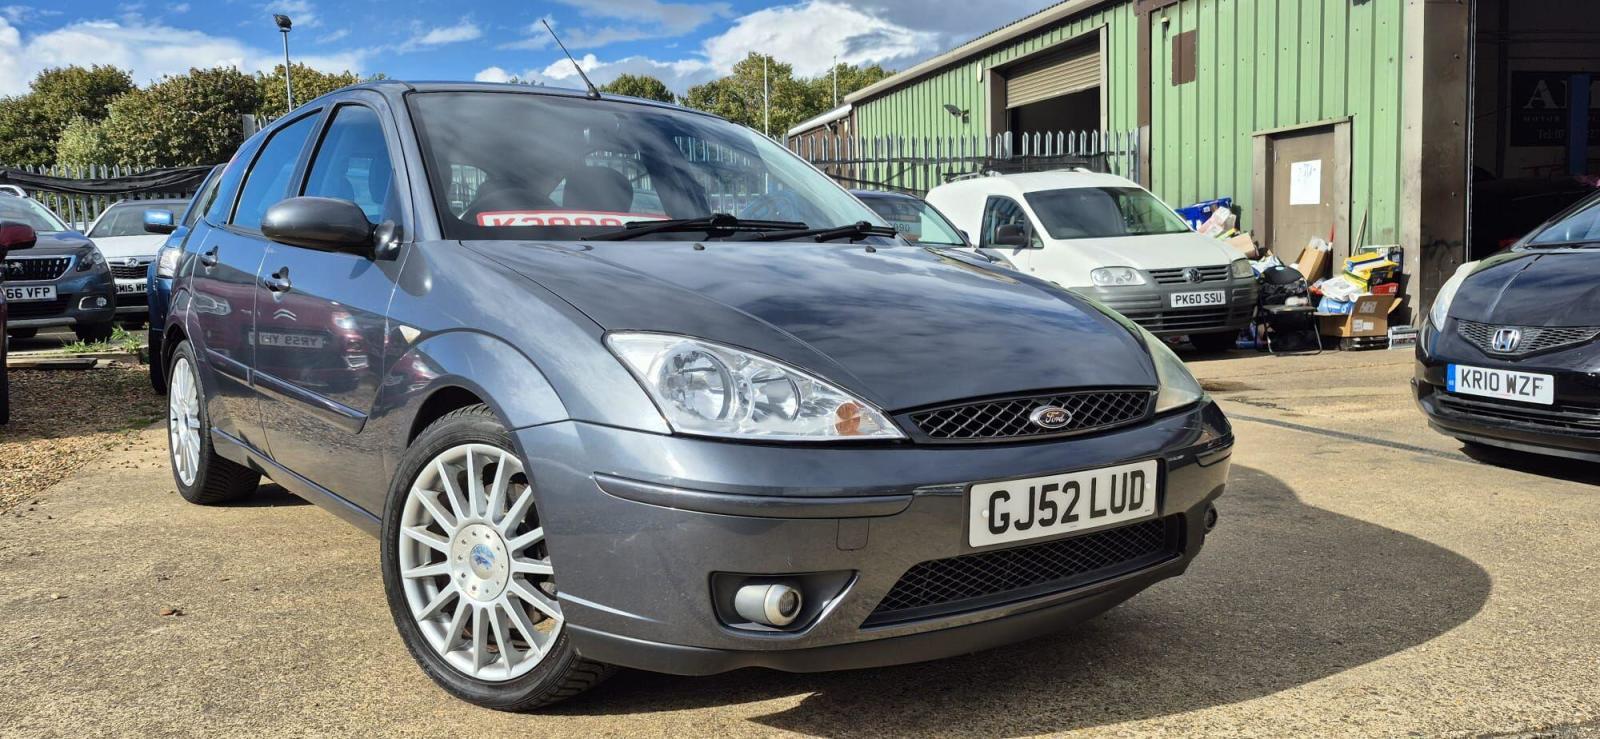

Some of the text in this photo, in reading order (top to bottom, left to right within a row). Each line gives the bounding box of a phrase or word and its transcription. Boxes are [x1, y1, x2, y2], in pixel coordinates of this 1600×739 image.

[25, 286, 51, 298] VFP
[1175, 292, 1222, 305] PK60 SSU
[1461, 368, 1545, 397] KR10 WZF
[988, 469, 1146, 535] GJ52 LUD
